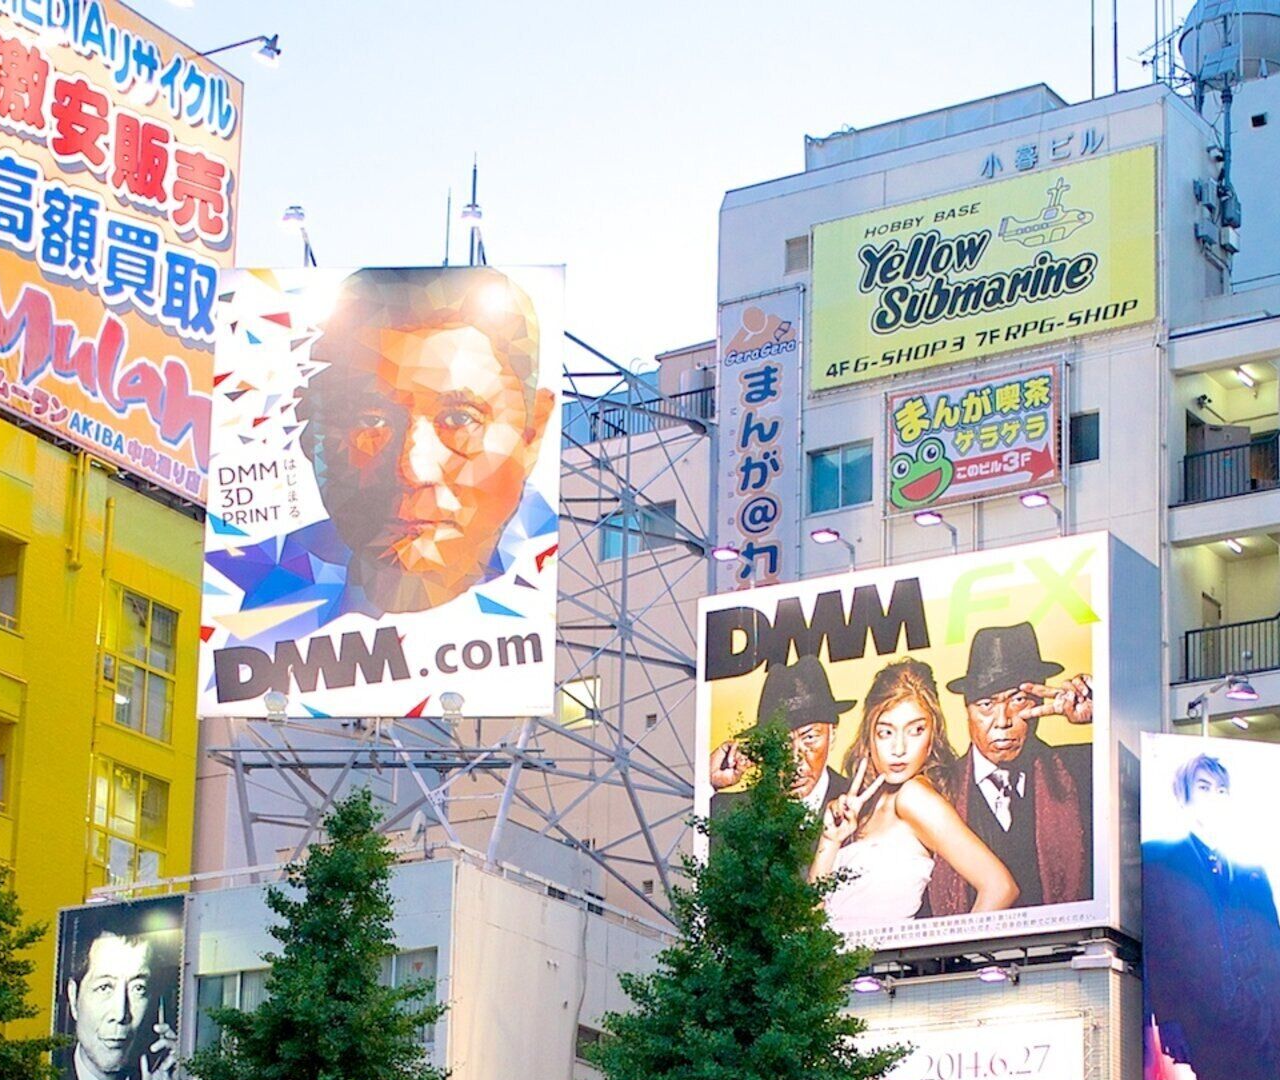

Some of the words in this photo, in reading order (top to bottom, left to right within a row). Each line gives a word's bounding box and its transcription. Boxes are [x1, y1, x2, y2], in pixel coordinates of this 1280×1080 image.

[864, 215, 925, 239] HOBBY
[933, 202, 981, 223] BASE
[860, 230, 991, 292] Yellow
[873, 252, 1097, 333] Submarine
[724, 340, 797, 366] GeraGera
[895, 374, 1051, 444] まんが喫茶
[69, 412, 126, 455] AKIBA
[954, 414, 1047, 454] ゲラゲラ
[218, 461, 279, 485] DMM
[740, 365, 781, 590] まんが@カ
[220, 487, 254, 508] 3D
[221, 505, 281, 528] PRINT
[705, 578, 931, 682] DMM
[944, 546, 1101, 645] FX
[213, 626, 544, 703] DMM.com
